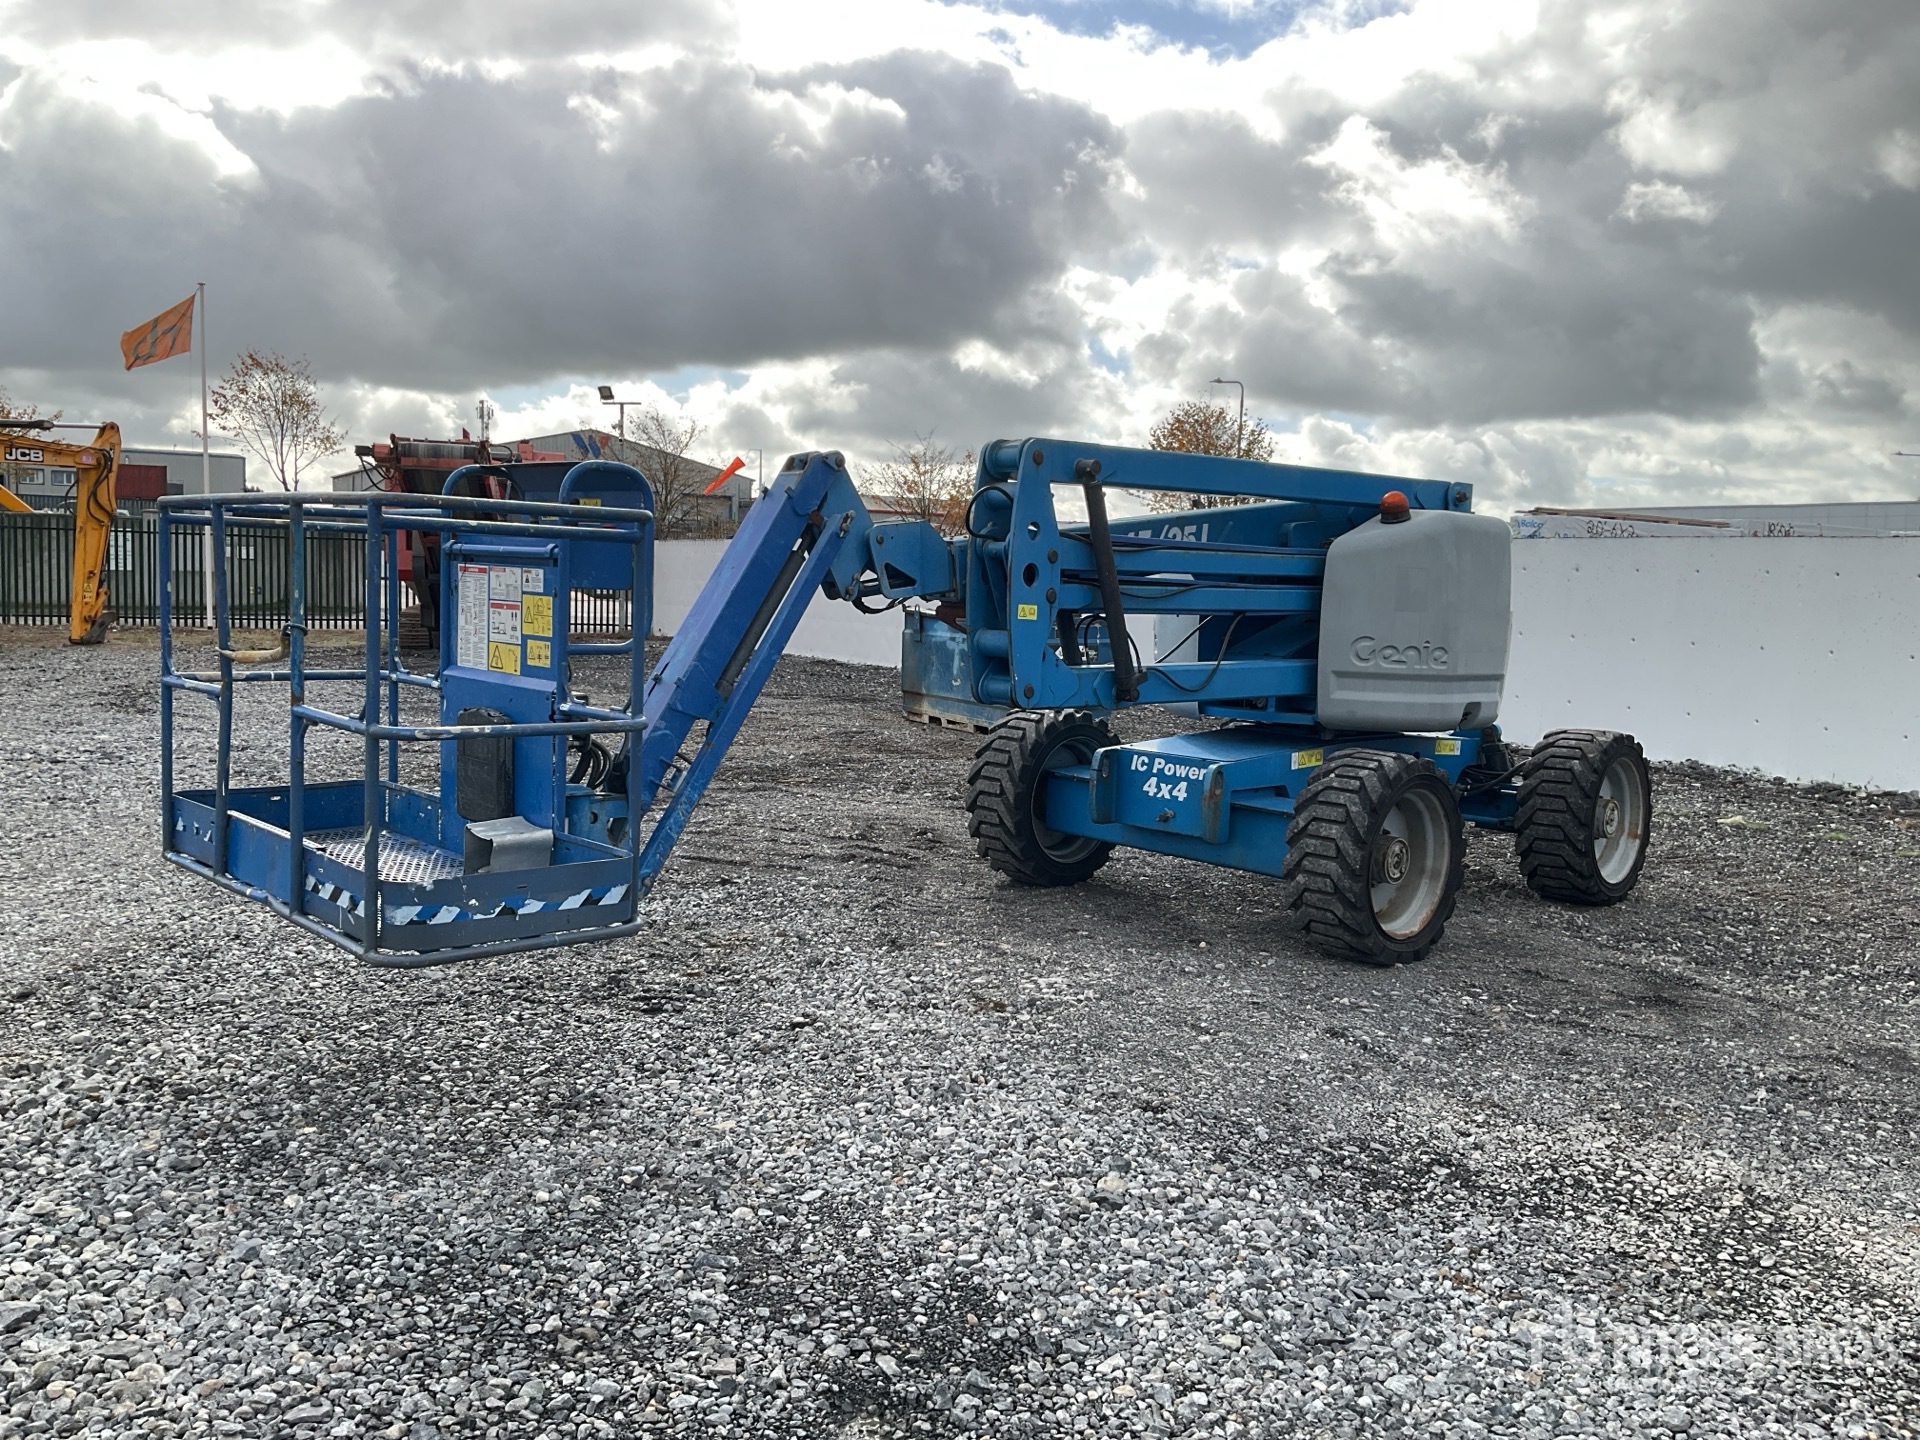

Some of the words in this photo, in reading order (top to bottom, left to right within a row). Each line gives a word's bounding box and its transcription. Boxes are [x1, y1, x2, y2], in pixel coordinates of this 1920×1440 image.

[5, 448, 43, 461] JCB
[1350, 636, 1448, 670] Genie
[1130, 755, 1149, 771] IC
[1152, 758, 1207, 780] Power
[1142, 777, 1188, 801] 4x4
